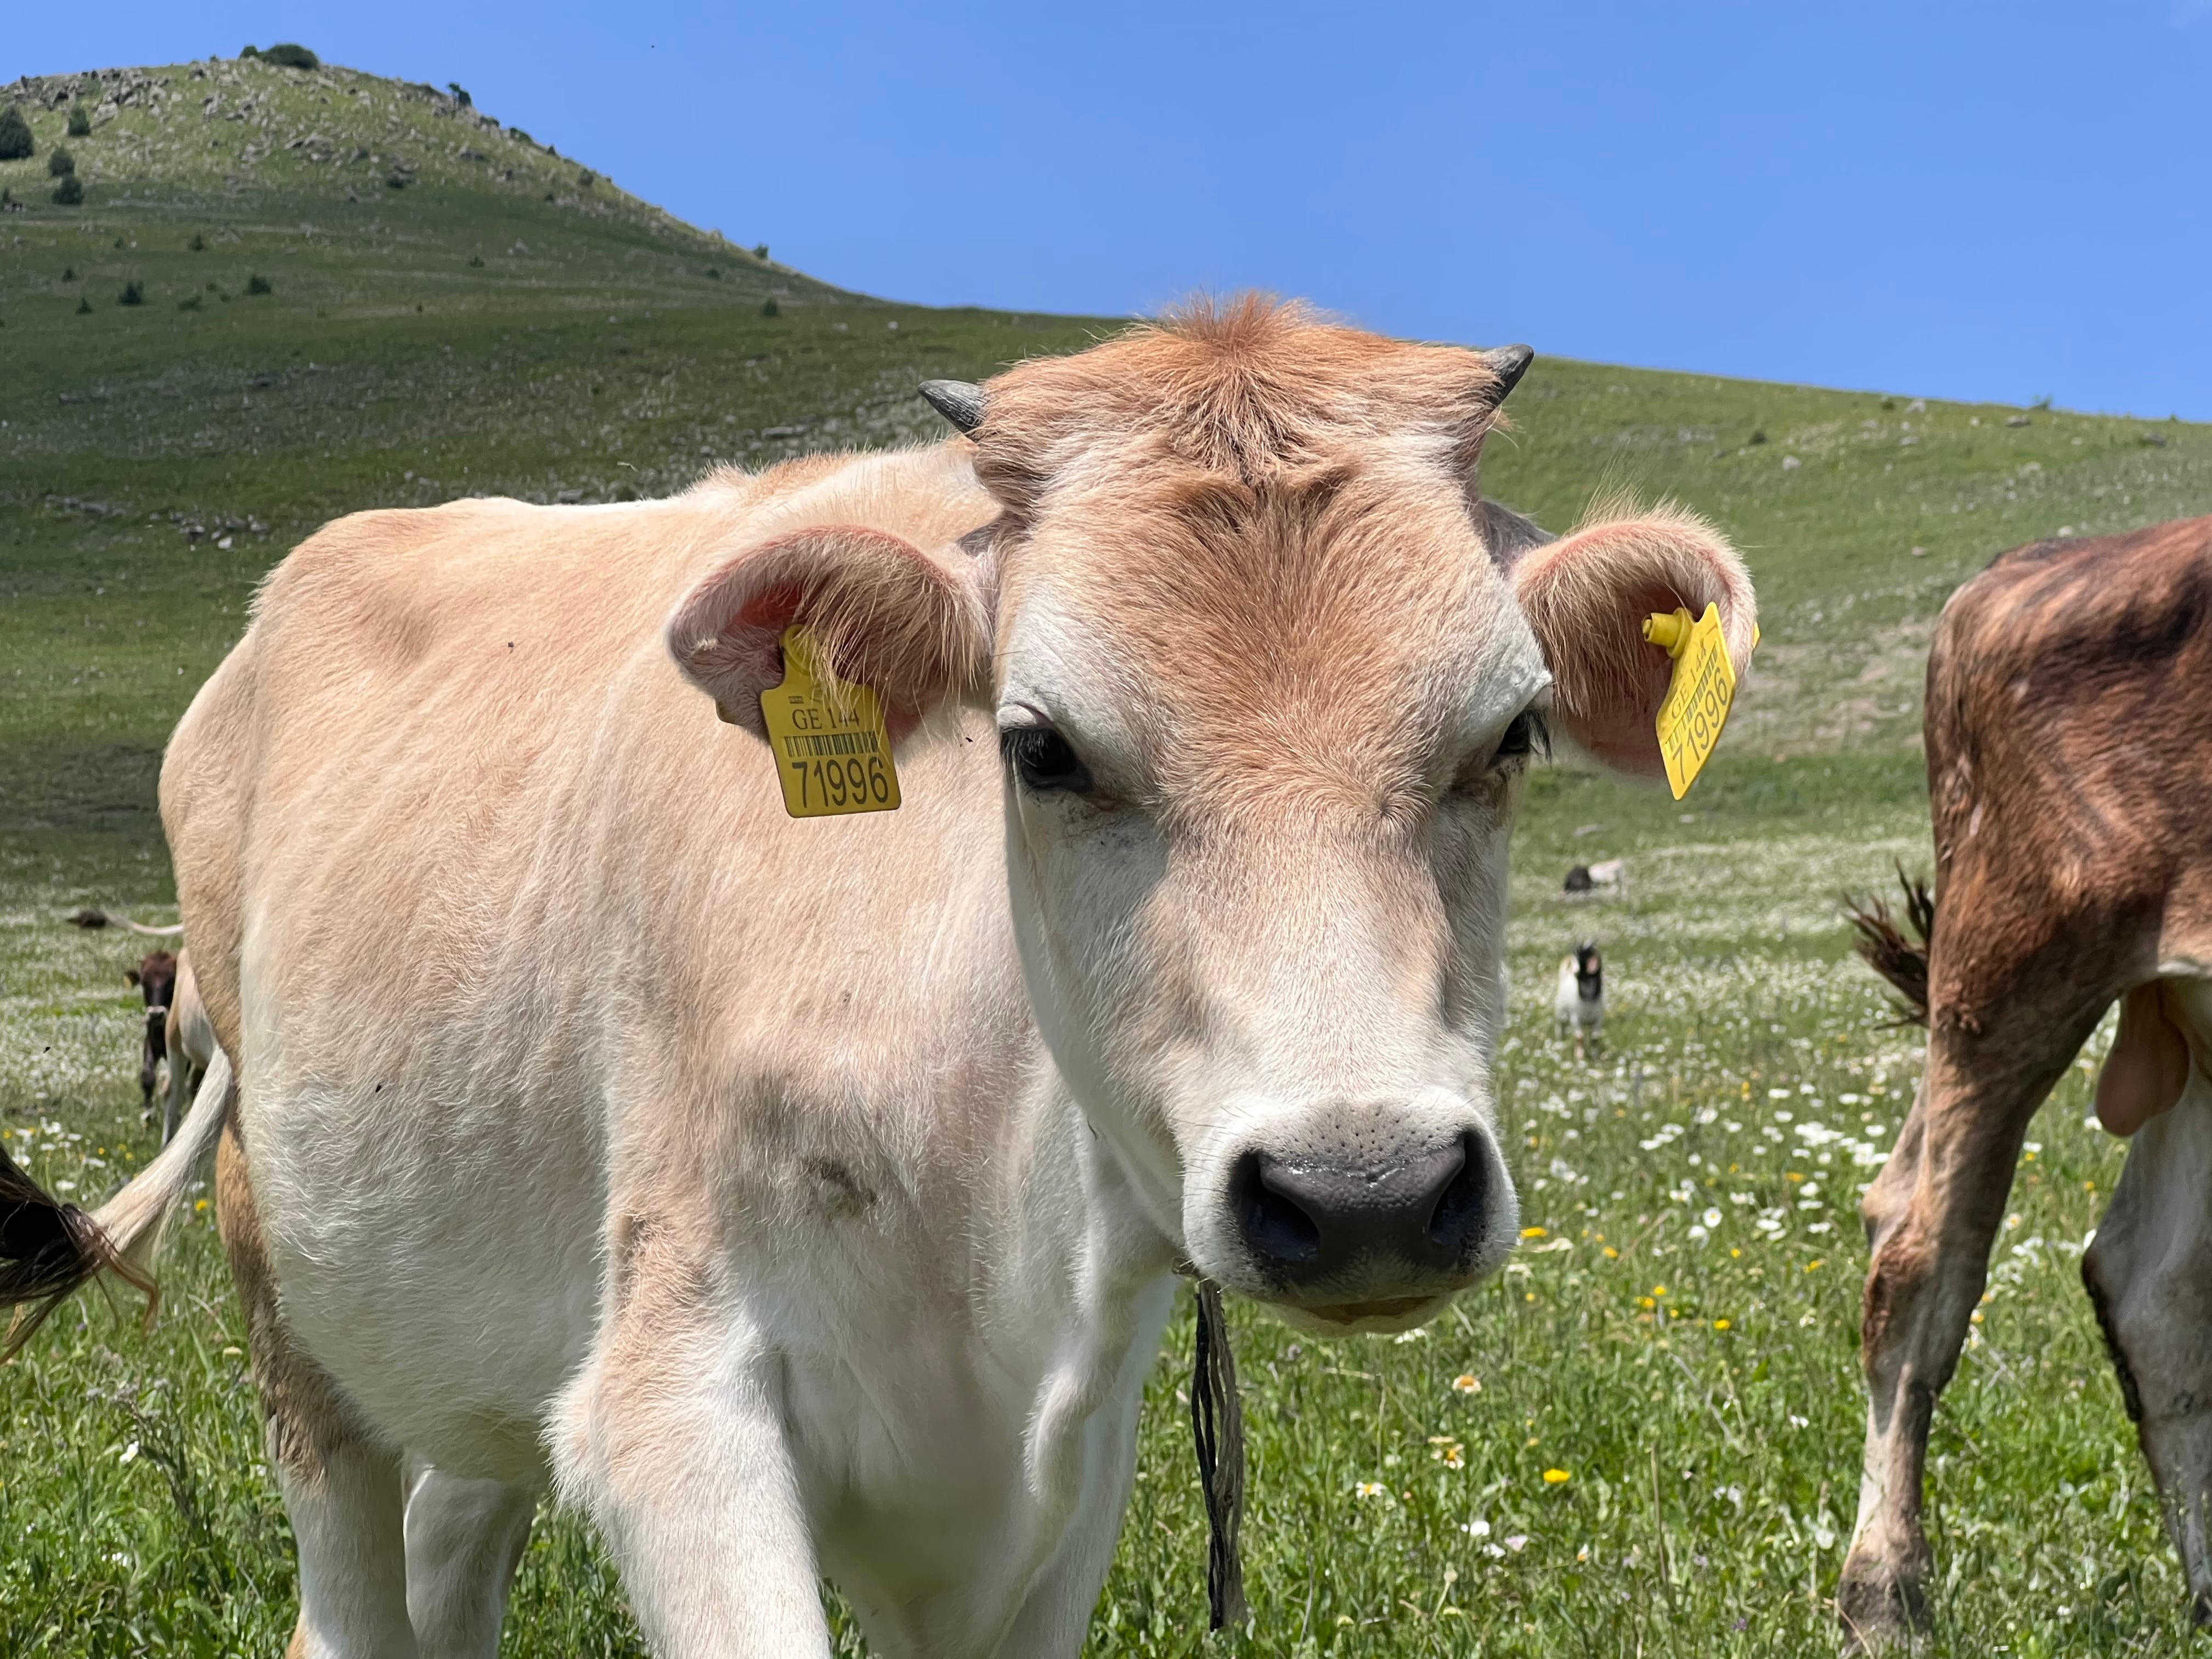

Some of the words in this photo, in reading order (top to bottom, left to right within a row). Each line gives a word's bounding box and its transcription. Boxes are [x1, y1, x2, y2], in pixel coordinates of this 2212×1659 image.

[792, 709, 822, 730] GE
[1672, 684, 1689, 719] GE
[1672, 667, 1727, 785] 71996
[792, 755, 889, 809] 71996
